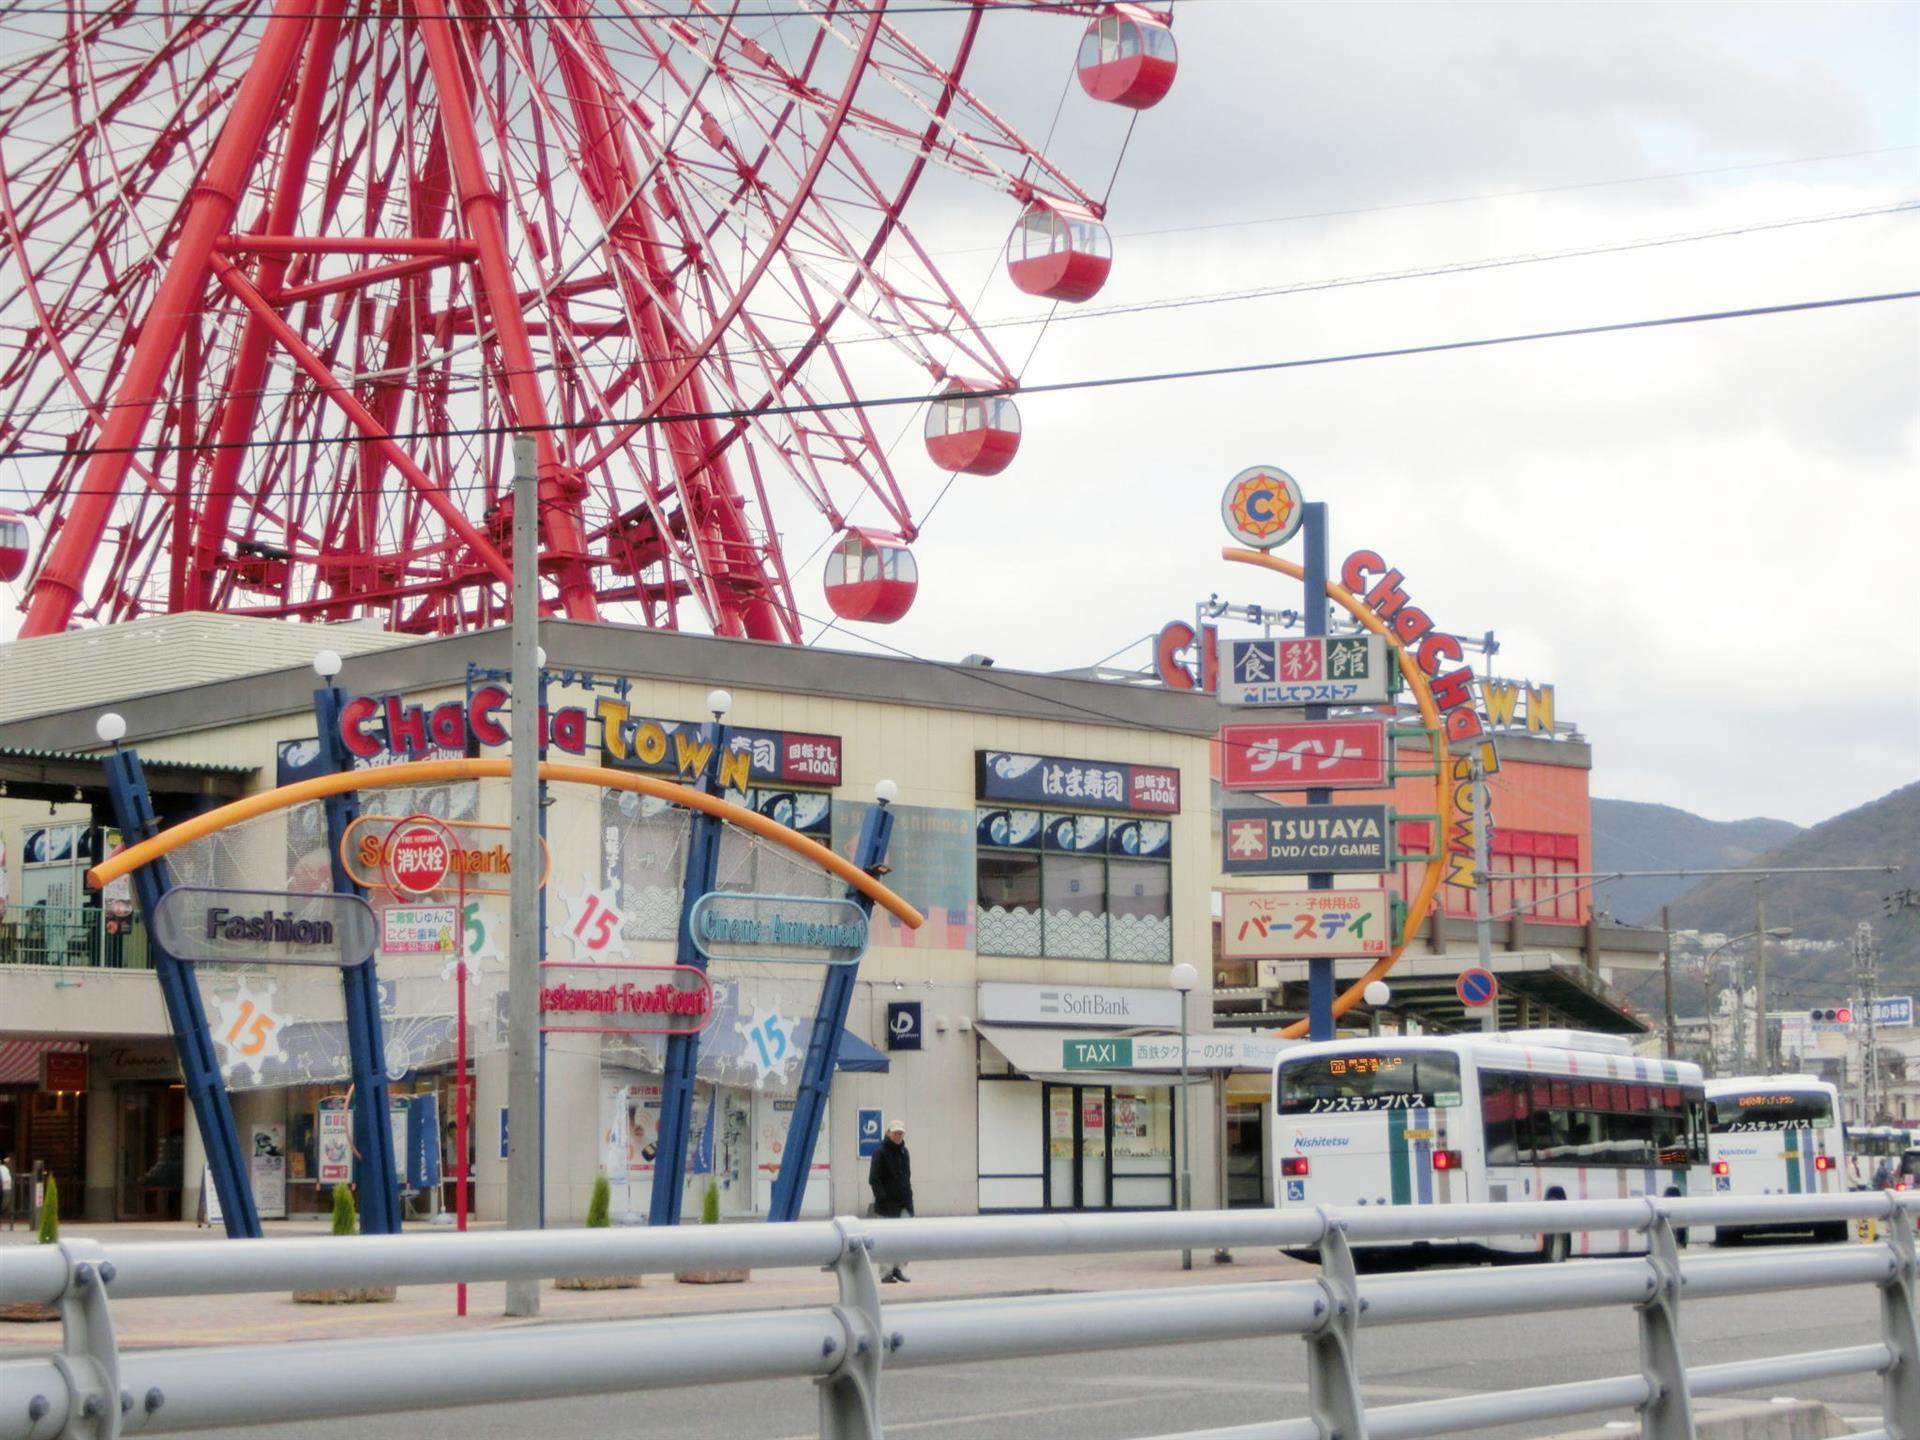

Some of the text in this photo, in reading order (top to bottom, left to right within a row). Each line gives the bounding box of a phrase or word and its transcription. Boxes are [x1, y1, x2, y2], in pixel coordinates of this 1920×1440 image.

[1234, 640, 1367, 683] 食彩館
[1262, 684, 1358, 702] にしてつストア
[788, 744, 838, 764] 回転すし
[1246, 738, 1363, 772] ダイソー
[1042, 765, 1123, 802] はま寿司
[1135, 775, 1176, 790] 回転すし
[1232, 823, 1264, 856] 本
[1271, 818, 1381, 840] TSUTAYA
[397, 846, 444, 873] 消火栓
[206, 907, 333, 944] Fashion
[573, 893, 620, 950] 15
[1238, 912, 1372, 941] バースデイ
[1063, 993, 1130, 1016] SoftBank
[225, 1000, 276, 1056] 15
[751, 1014, 787, 1069] 15
[1075, 1044, 1116, 1063] TAXI
[1310, 1094, 1426, 1113] ノンステップバス
[1728, 1119, 1811, 1133] ノンステップバス
[1294, 1137, 1350, 1149] Nishitetsu
